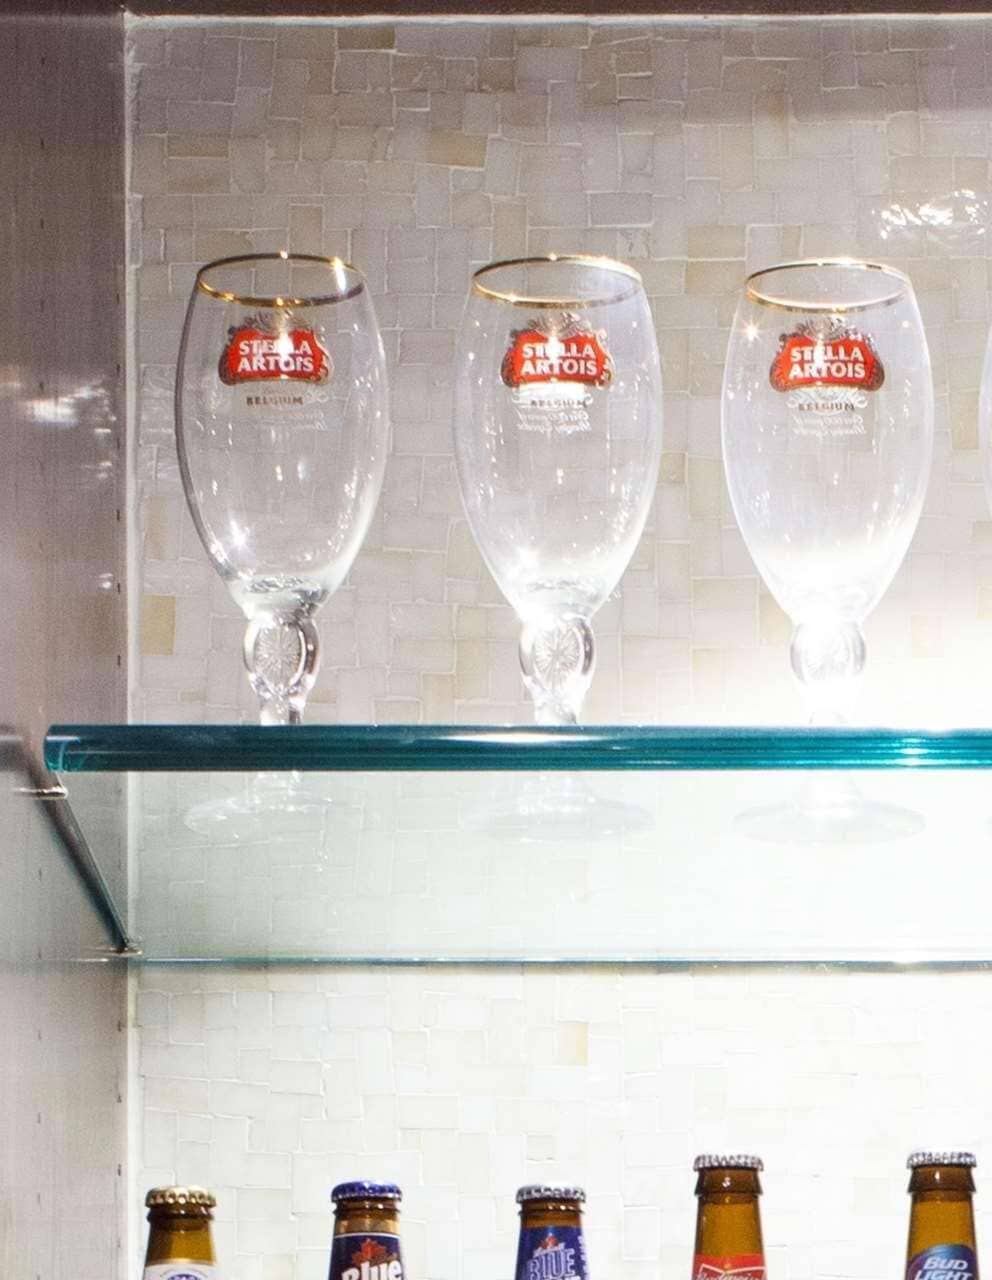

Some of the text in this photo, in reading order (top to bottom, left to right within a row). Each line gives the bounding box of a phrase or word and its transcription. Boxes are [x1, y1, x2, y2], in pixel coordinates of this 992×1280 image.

[521, 359, 598, 376] ARTOIS
[788, 362, 866, 379] ARTOIS
[922, 1256, 969, 1271] BUD
